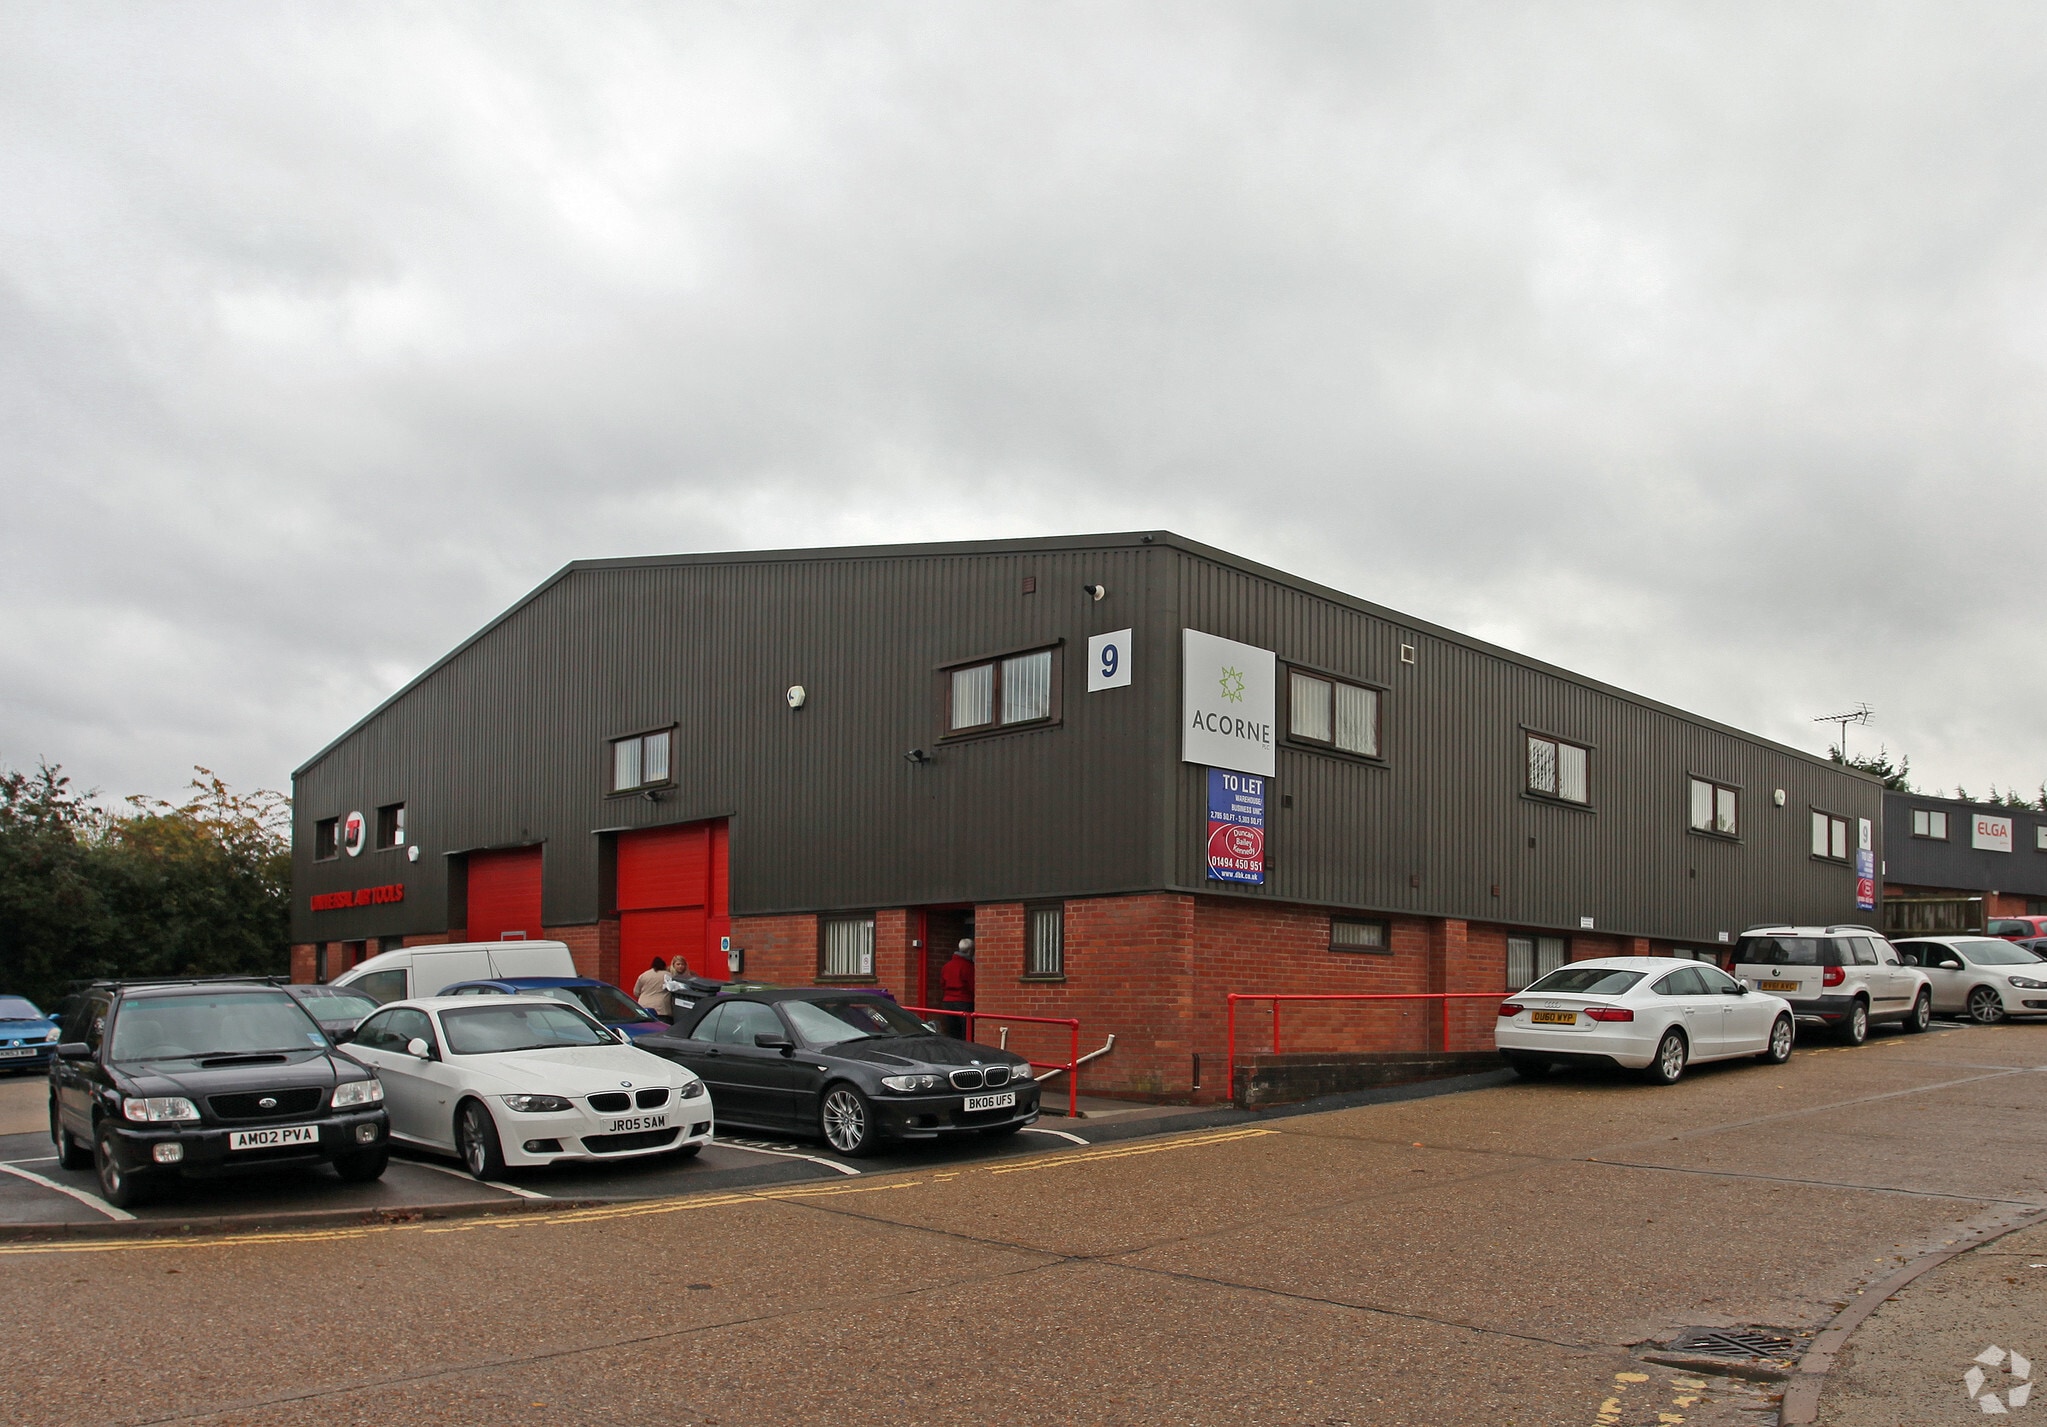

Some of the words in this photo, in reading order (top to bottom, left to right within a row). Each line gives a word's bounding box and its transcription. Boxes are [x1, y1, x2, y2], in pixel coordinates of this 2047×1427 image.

[1101, 644, 1119, 678] 9
[1193, 710, 1270, 744] ACORNE
[1223, 774, 1239, 791] TO
[1242, 777, 1263, 795] LET
[1234, 830, 1254, 840] Duncan
[1978, 822, 2008, 838] ELGA
[1212, 856, 1233, 868] 01494
[1235, 860, 1249, 870] 450
[1250, 862, 1262, 872] 951
[372, 883, 404, 904] TOOLS
[969, 1097, 994, 1109] BK06
[996, 1095, 1012, 1106] UFS
[609, 1119, 641, 1132] JR05
[643, 1116, 665, 1129] SAM
[239, 1132, 278, 1147] AM02
[283, 1128, 312, 1142] PVA
